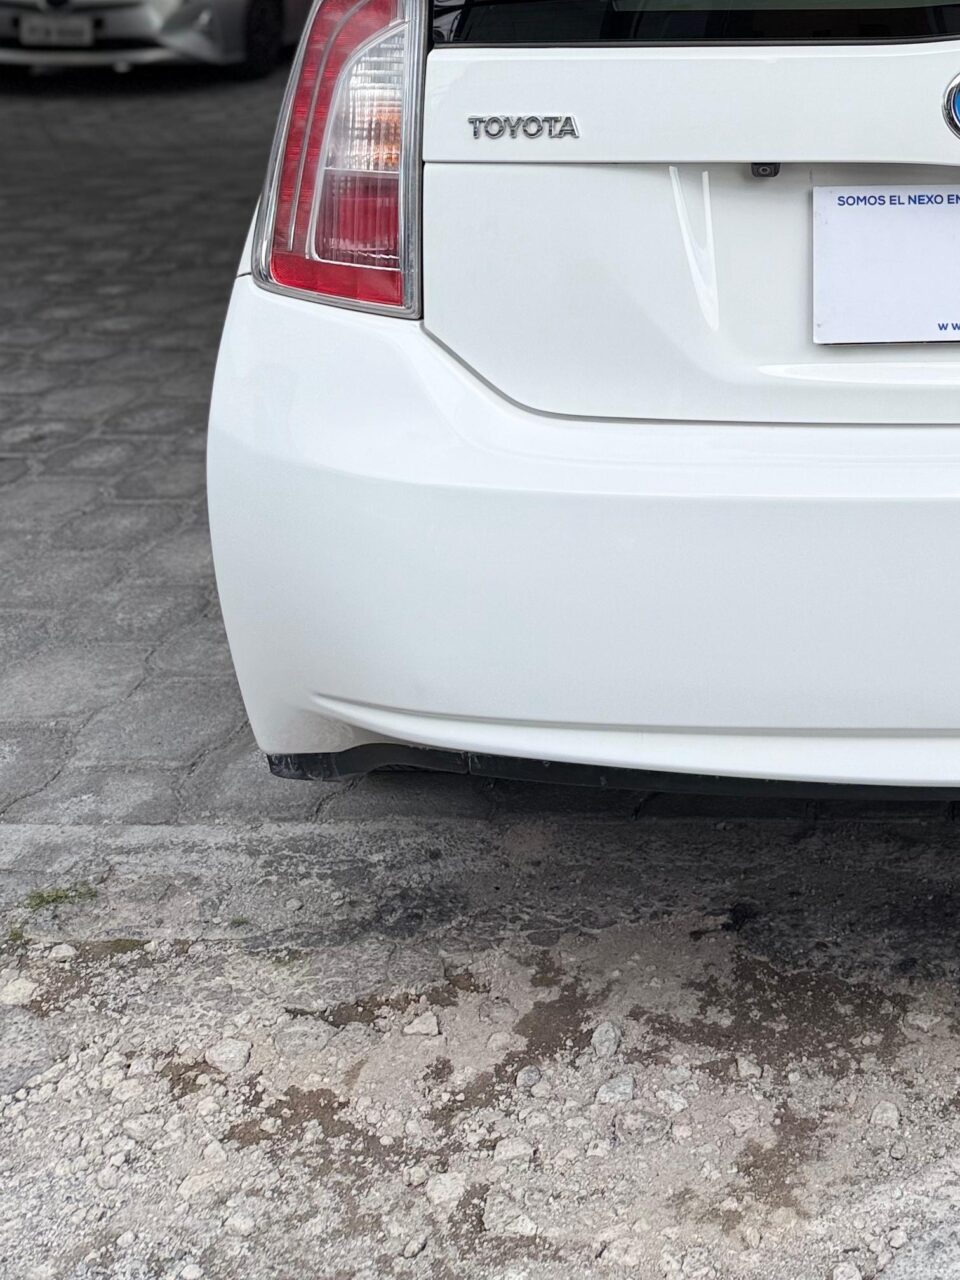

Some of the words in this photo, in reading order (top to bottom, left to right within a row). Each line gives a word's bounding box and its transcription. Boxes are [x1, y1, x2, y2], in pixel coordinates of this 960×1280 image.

[468, 115, 580, 139] TOYOTA
[837, 195, 886, 206] SOMOS
[889, 195, 905, 206] EL
[908, 194, 944, 205] NEXO
